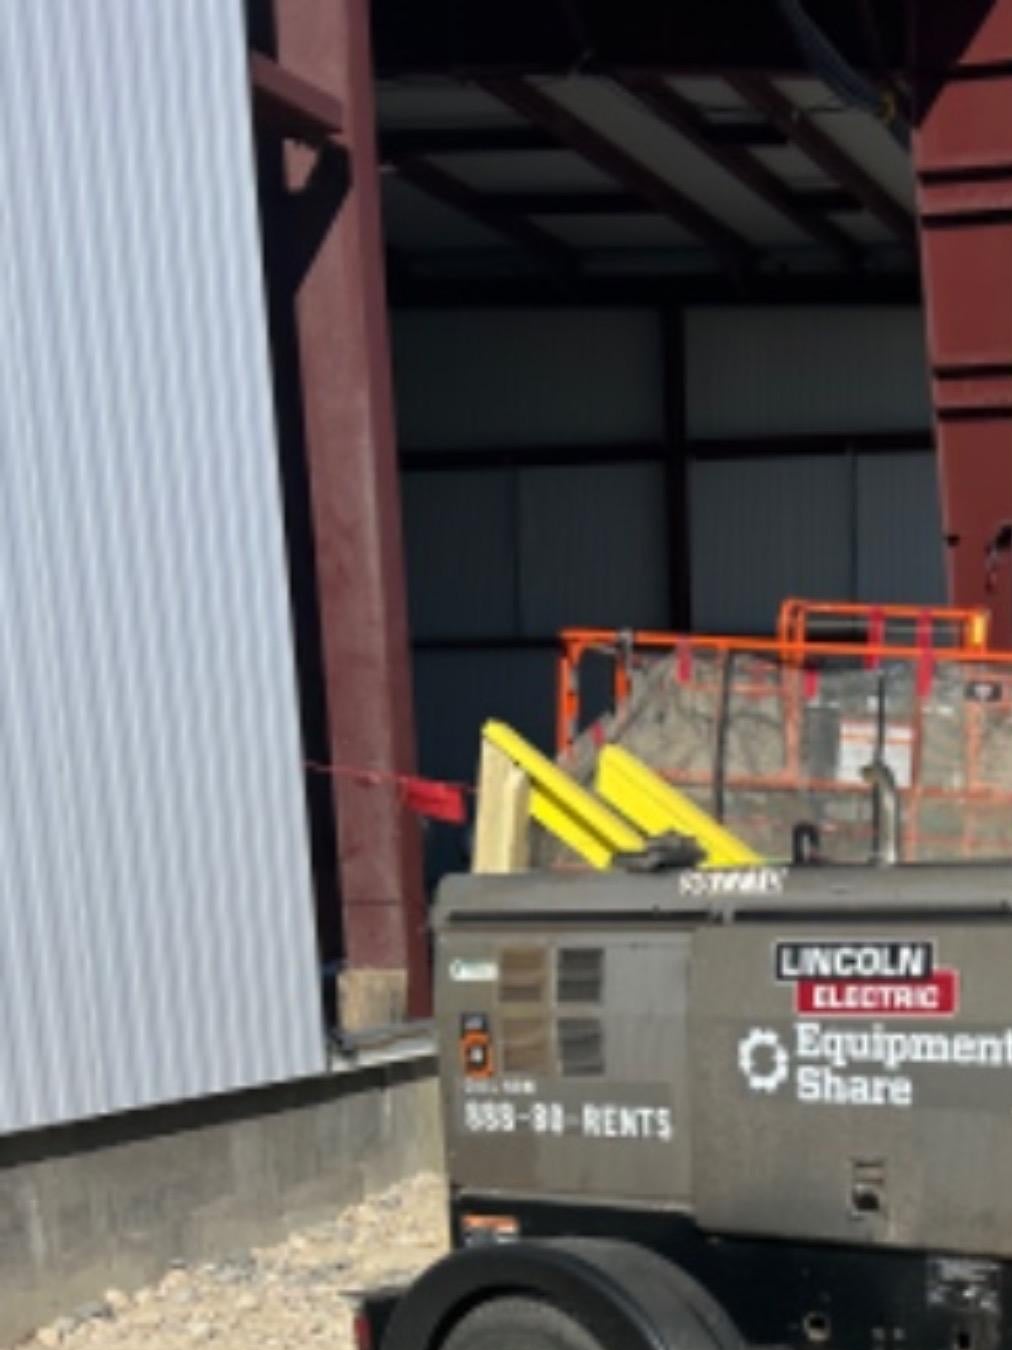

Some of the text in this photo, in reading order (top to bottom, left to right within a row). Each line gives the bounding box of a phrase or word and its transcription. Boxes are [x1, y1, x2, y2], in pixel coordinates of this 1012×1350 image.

[781, 947, 925, 977] LINCOLN
[812, 985, 940, 1010] ELECTRIC
[796, 1065, 914, 1106] Share
